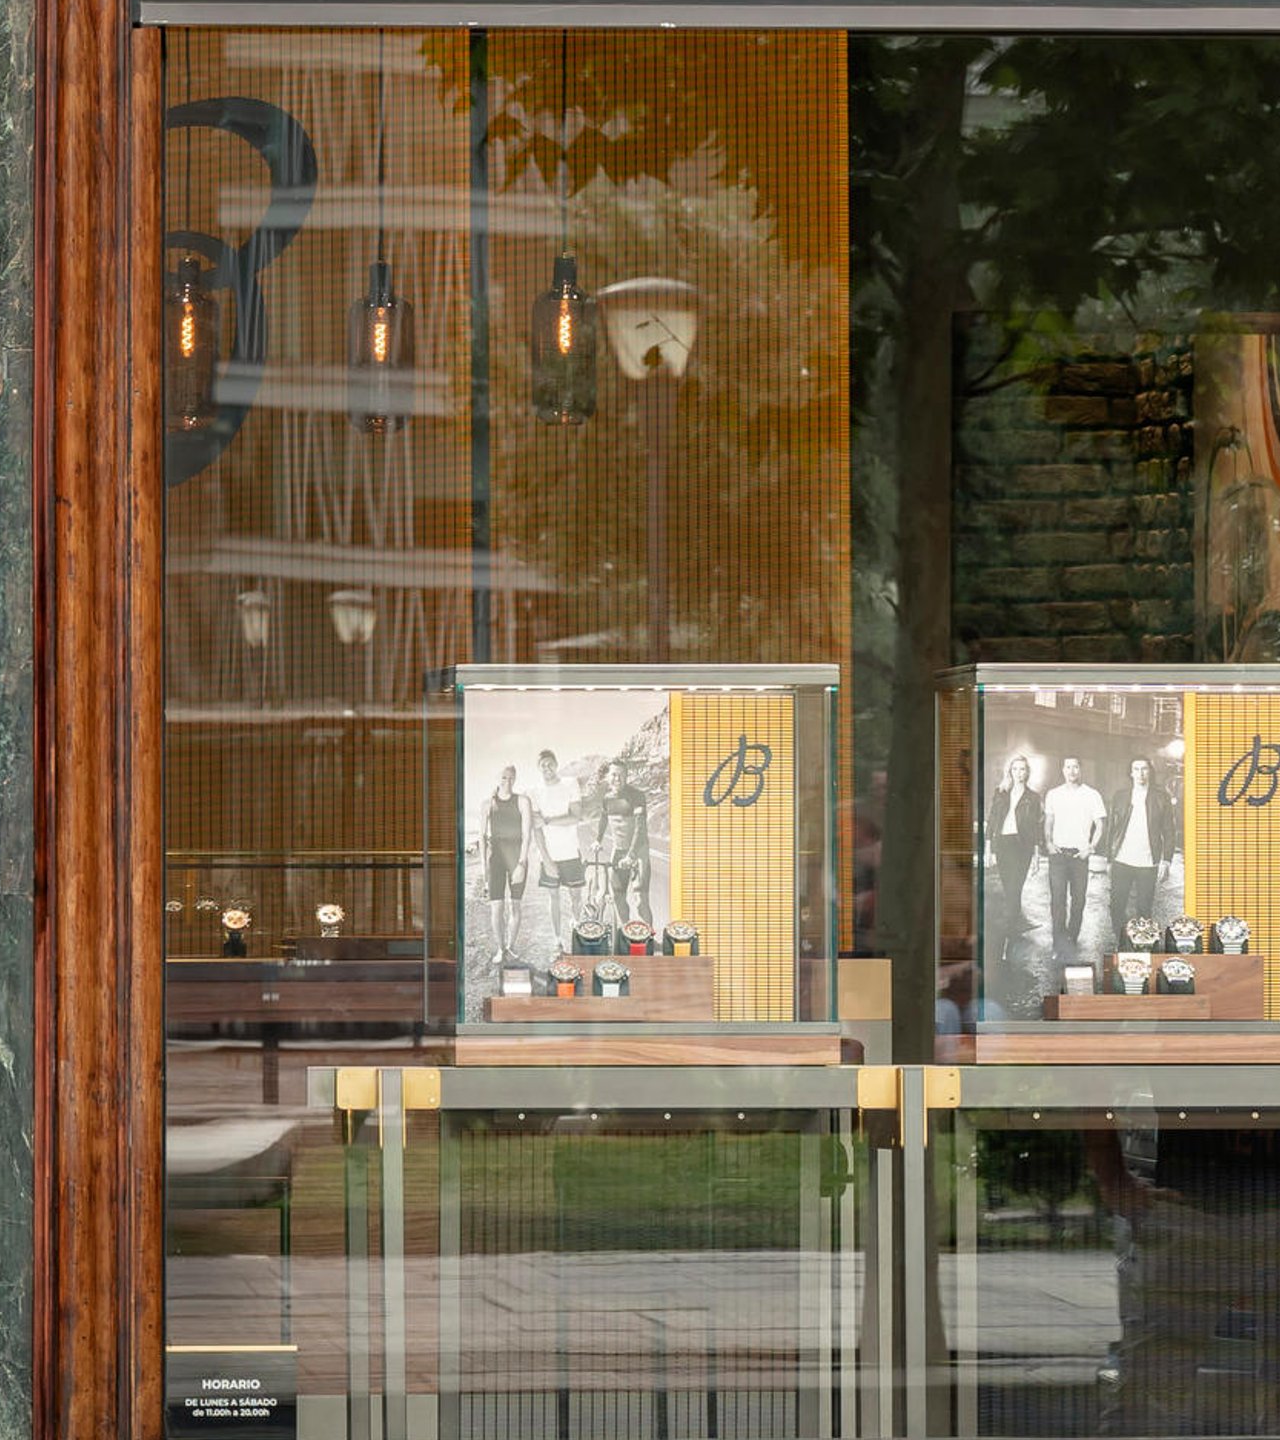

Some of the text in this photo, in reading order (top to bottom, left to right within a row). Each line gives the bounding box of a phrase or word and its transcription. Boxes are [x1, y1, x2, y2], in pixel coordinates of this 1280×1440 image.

[201, 1379, 261, 1390] HORARIO
[184, 1396, 278, 1407] DE LUNES A SÁBADO
[192, 1408, 205, 1417] de
